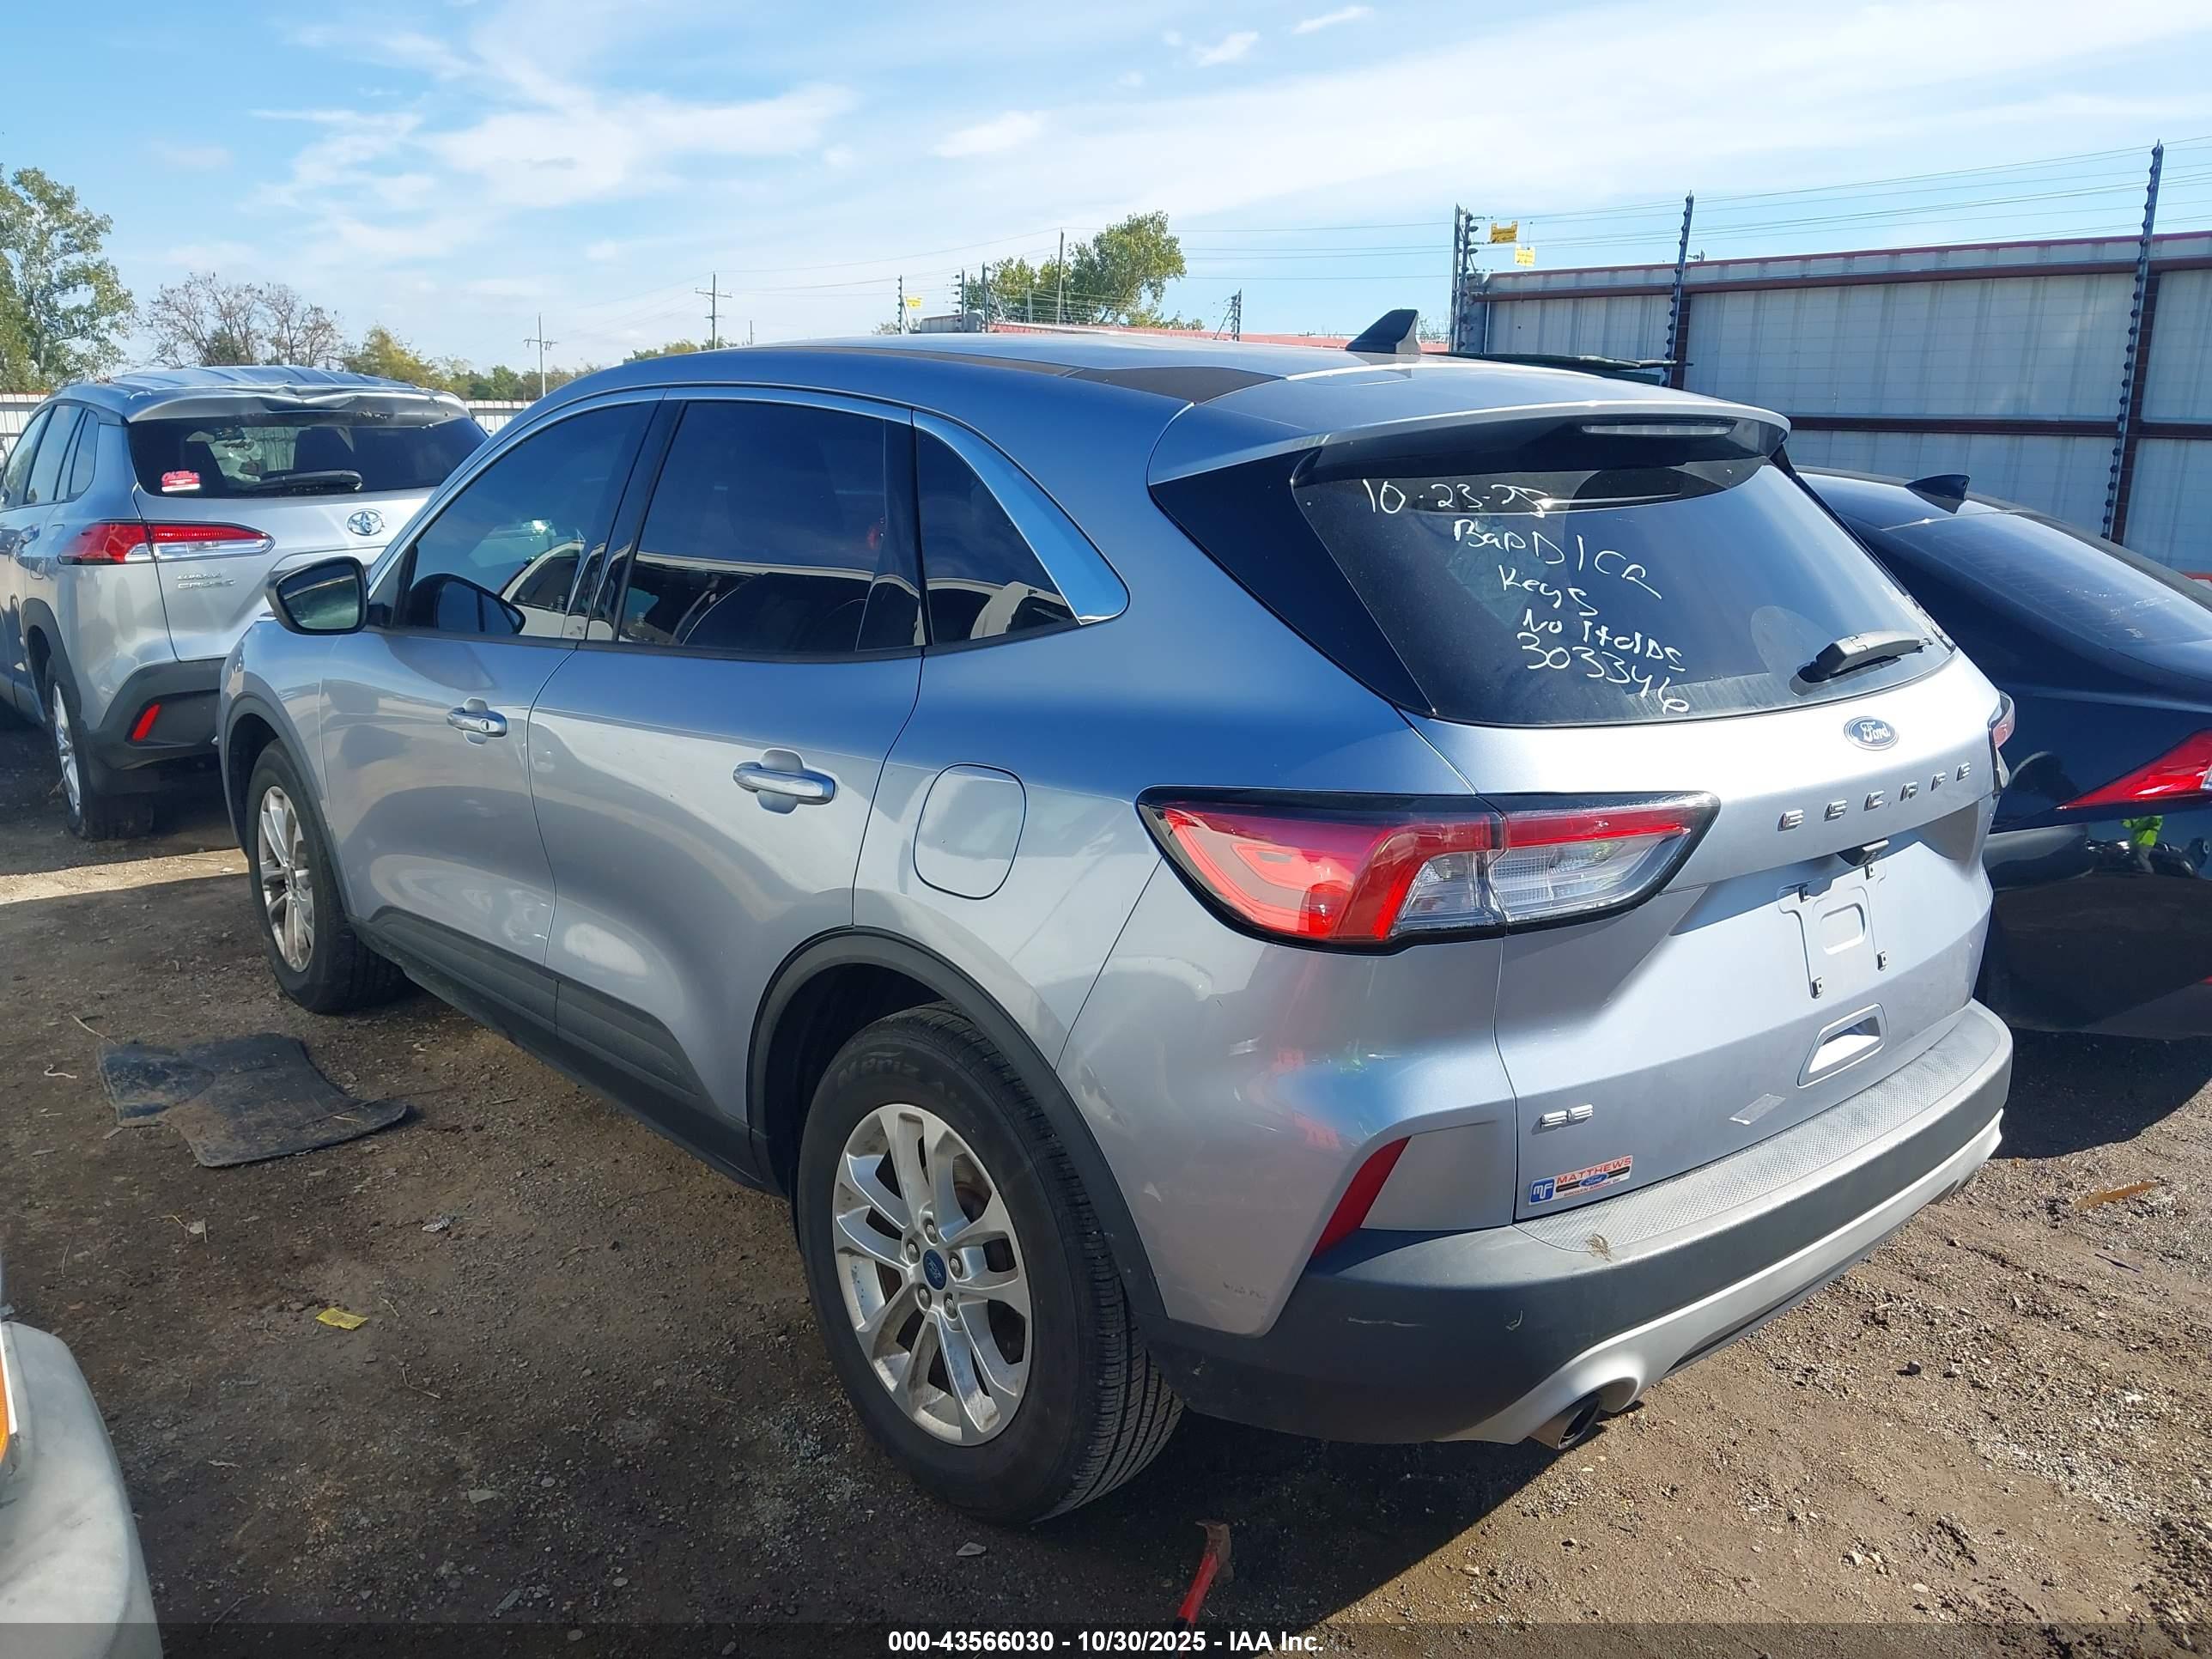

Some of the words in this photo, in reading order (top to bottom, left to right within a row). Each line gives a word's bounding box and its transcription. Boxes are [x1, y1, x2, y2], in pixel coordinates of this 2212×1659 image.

[1498, 564, 1599, 617] Keys
[1522, 608, 1563, 634] No
[1557, 1157, 1632, 1184] MATTHEWS
